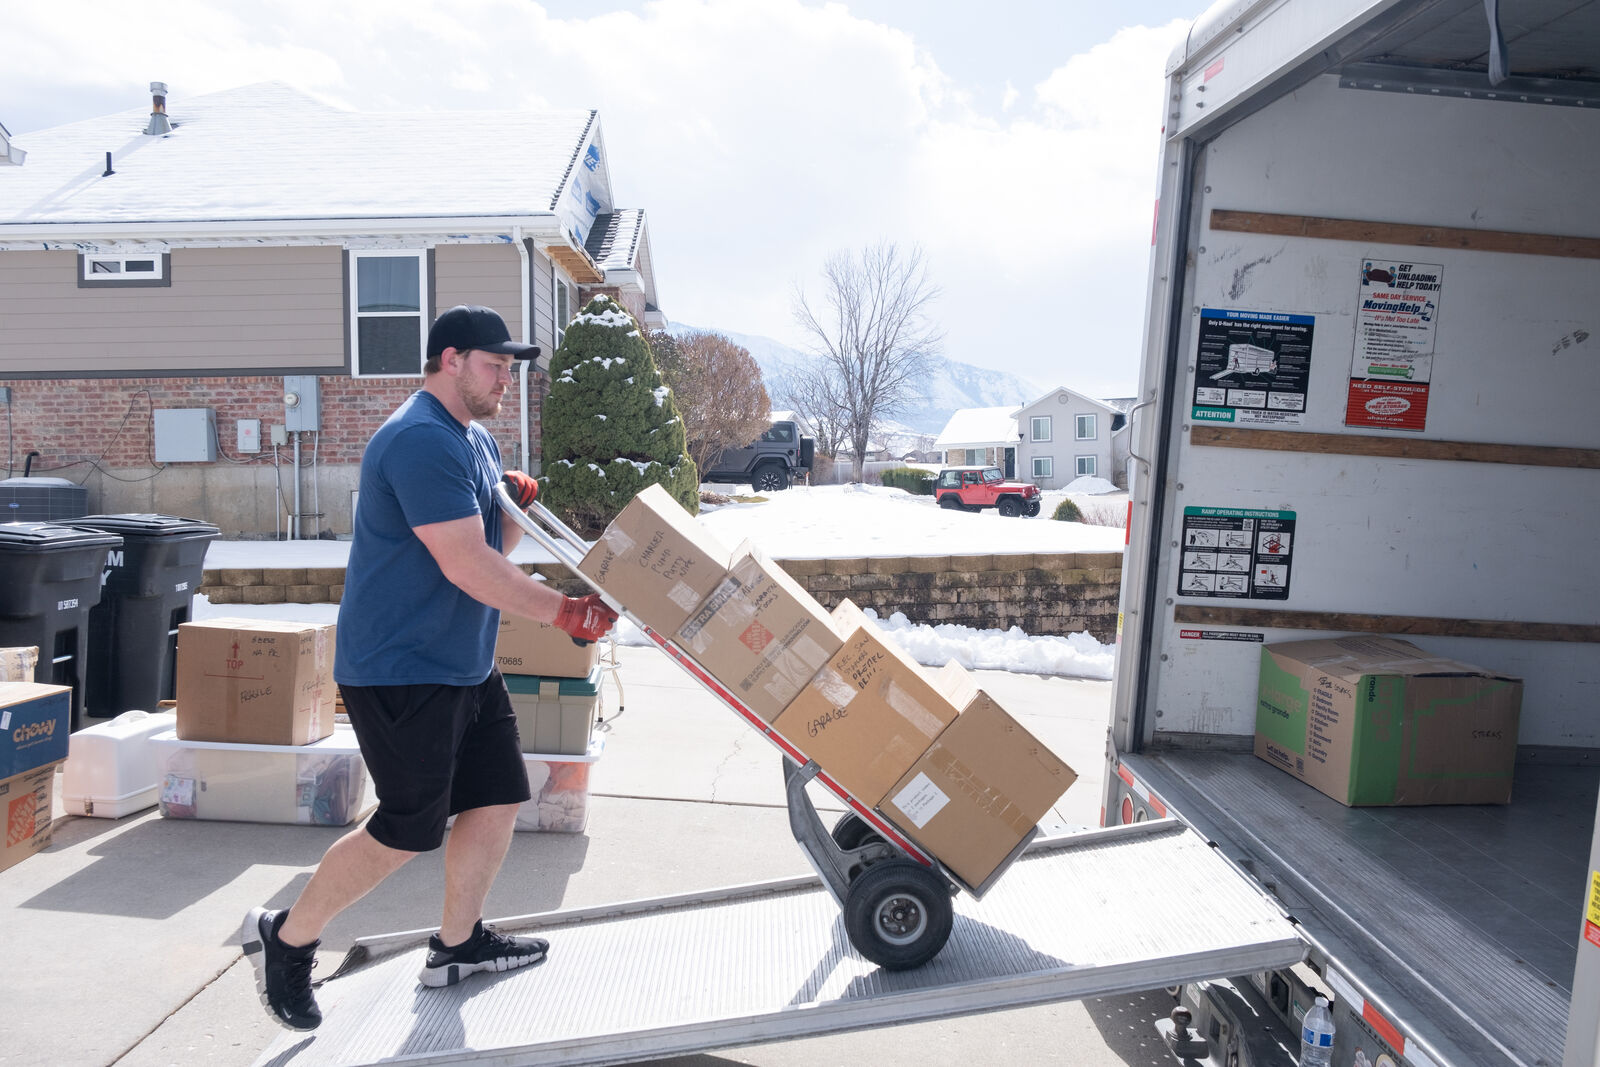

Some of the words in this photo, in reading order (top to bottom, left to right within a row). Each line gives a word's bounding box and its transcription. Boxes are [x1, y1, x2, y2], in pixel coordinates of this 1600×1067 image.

[1399, 264, 1413, 272] GET
[1397, 273, 1437, 282] UNLOADING
[1396, 281, 1414, 289] HELP
[1416, 282, 1440, 292] TODAY!
[1196, 410, 1231, 418] ATTENTION
[683, 607, 713, 638] EXTRA
[226, 659, 244, 670] TOP
[497, 656, 523, 666] 70685
[1316, 696, 1332, 706] Bedroom
[1316, 703, 1327, 712] Family
[1327, 708, 1339, 716] Room
[808, 708, 848, 737] GARAGE
[1315, 710, 1326, 720] Dining
[1326, 715, 1338, 724] Room
[13, 718, 56, 743] chewy
